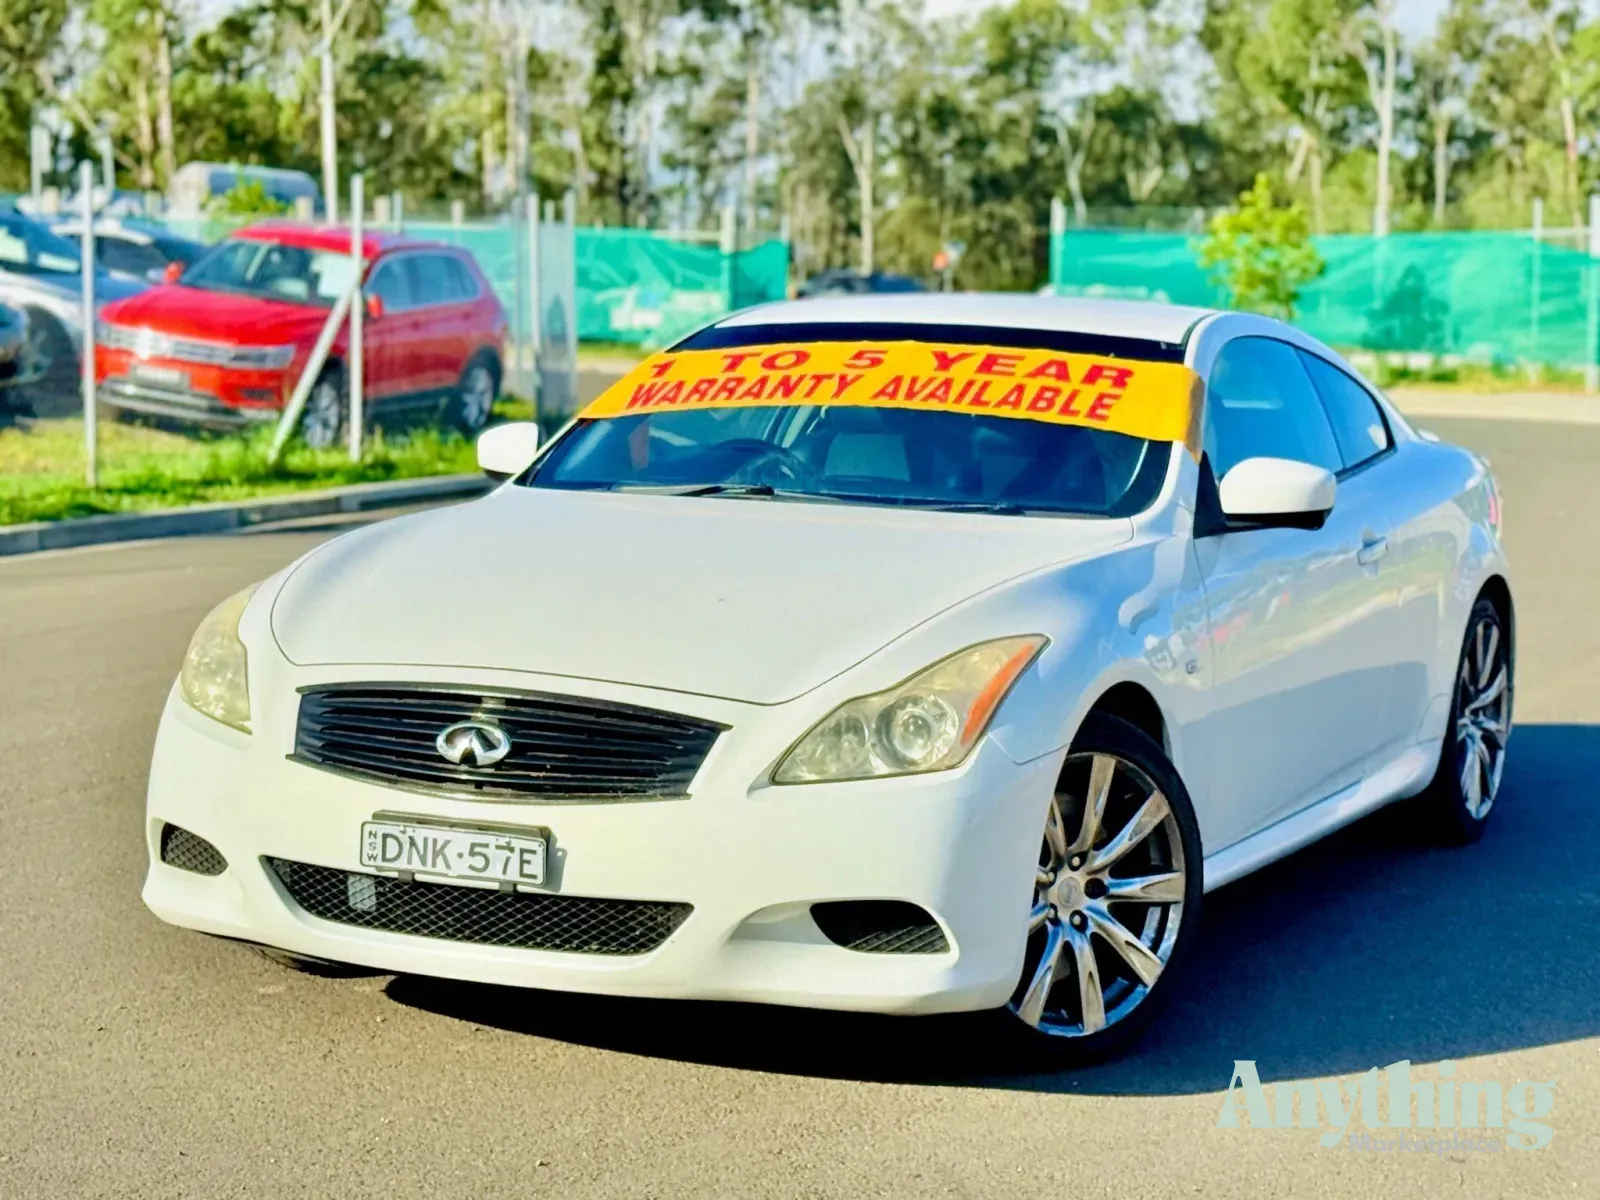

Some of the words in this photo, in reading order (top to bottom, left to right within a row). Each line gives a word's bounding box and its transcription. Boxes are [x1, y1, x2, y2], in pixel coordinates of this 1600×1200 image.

[650, 360, 677, 378] 1
[719, 350, 811, 373] TO
[843, 350, 888, 370] 5
[930, 351, 1135, 389] YEAR
[626, 374, 866, 410] WARRANTY
[871, 374, 1122, 422] AVAILABLE
